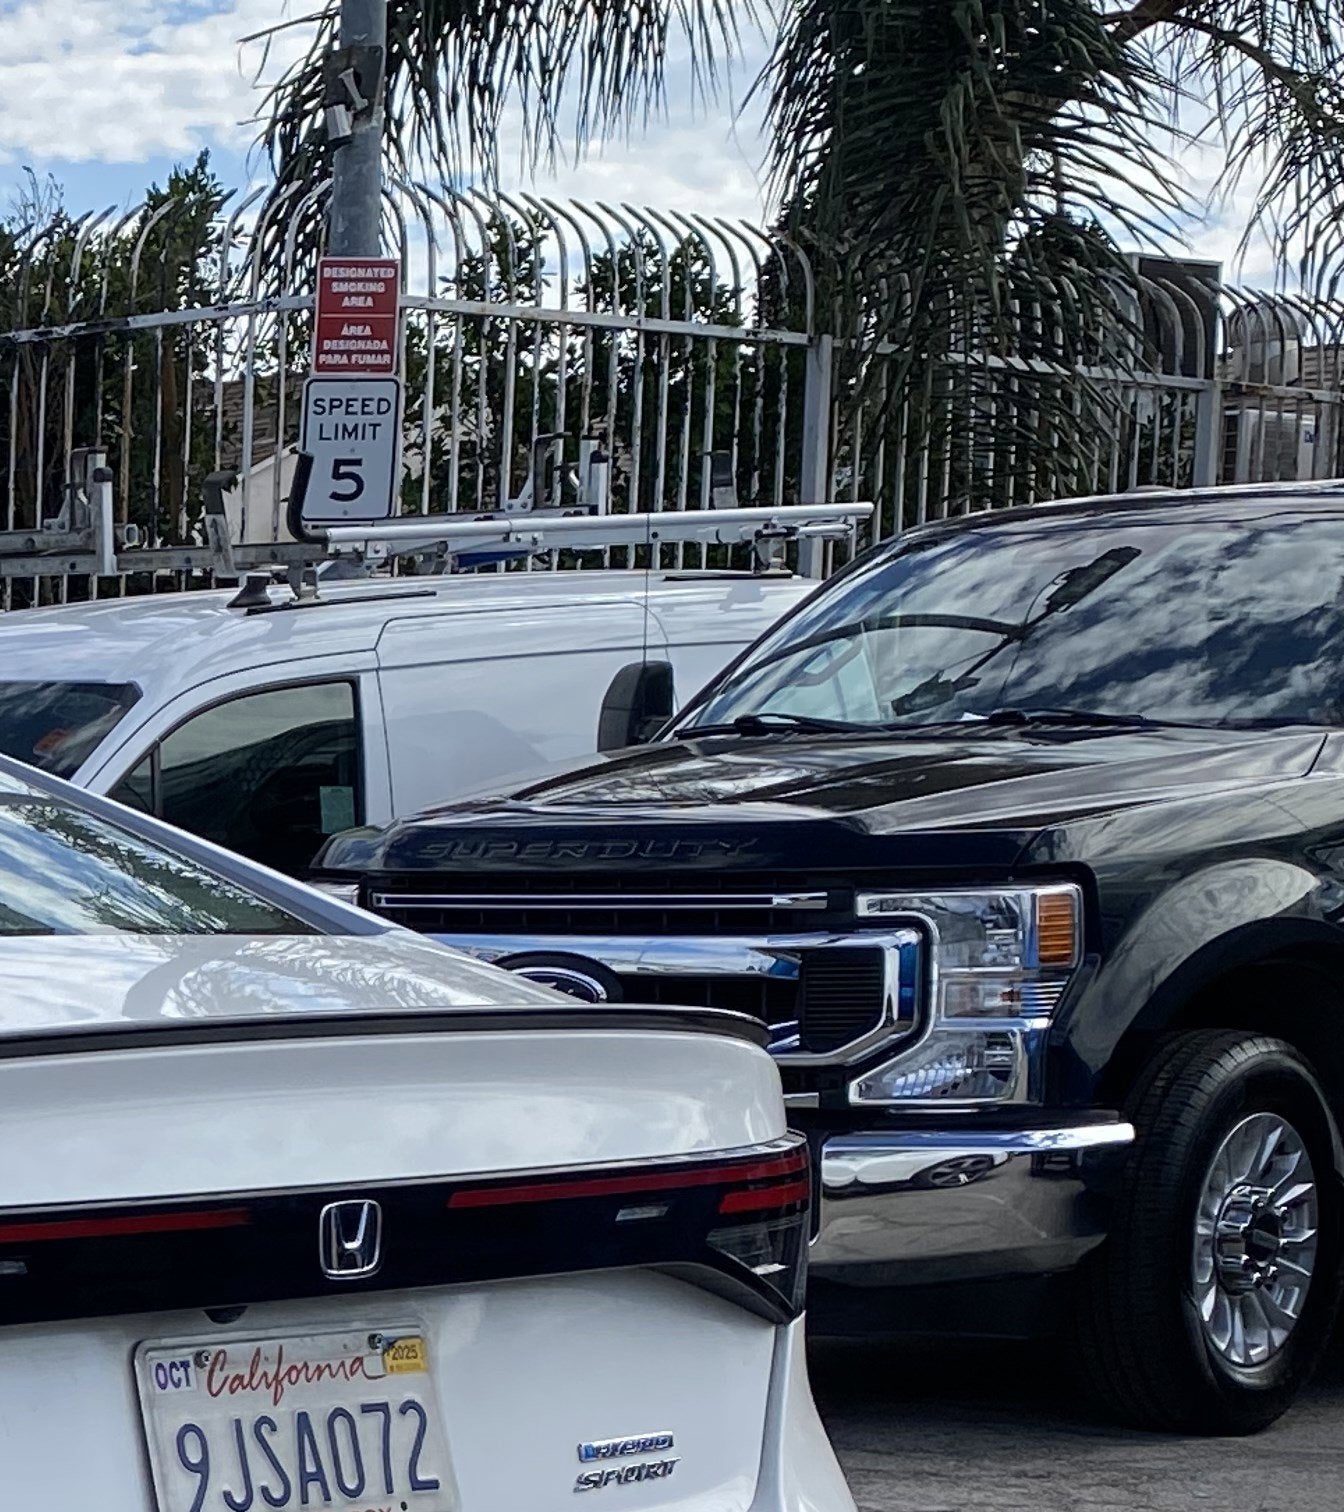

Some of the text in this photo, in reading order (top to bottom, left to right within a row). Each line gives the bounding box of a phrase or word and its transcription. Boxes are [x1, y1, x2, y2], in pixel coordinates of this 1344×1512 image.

[323, 267, 396, 278] DESIGNATED
[331, 281, 386, 293] SMOKING
[341, 296, 374, 307] AREA
[318, 354, 391, 365] PARA FUMAR
[312, 397, 392, 416] SPEED
[318, 423, 382, 441] LIMIT
[328, 458, 365, 501] 5
[154, 1343, 419, 1407] OCT California 2025
